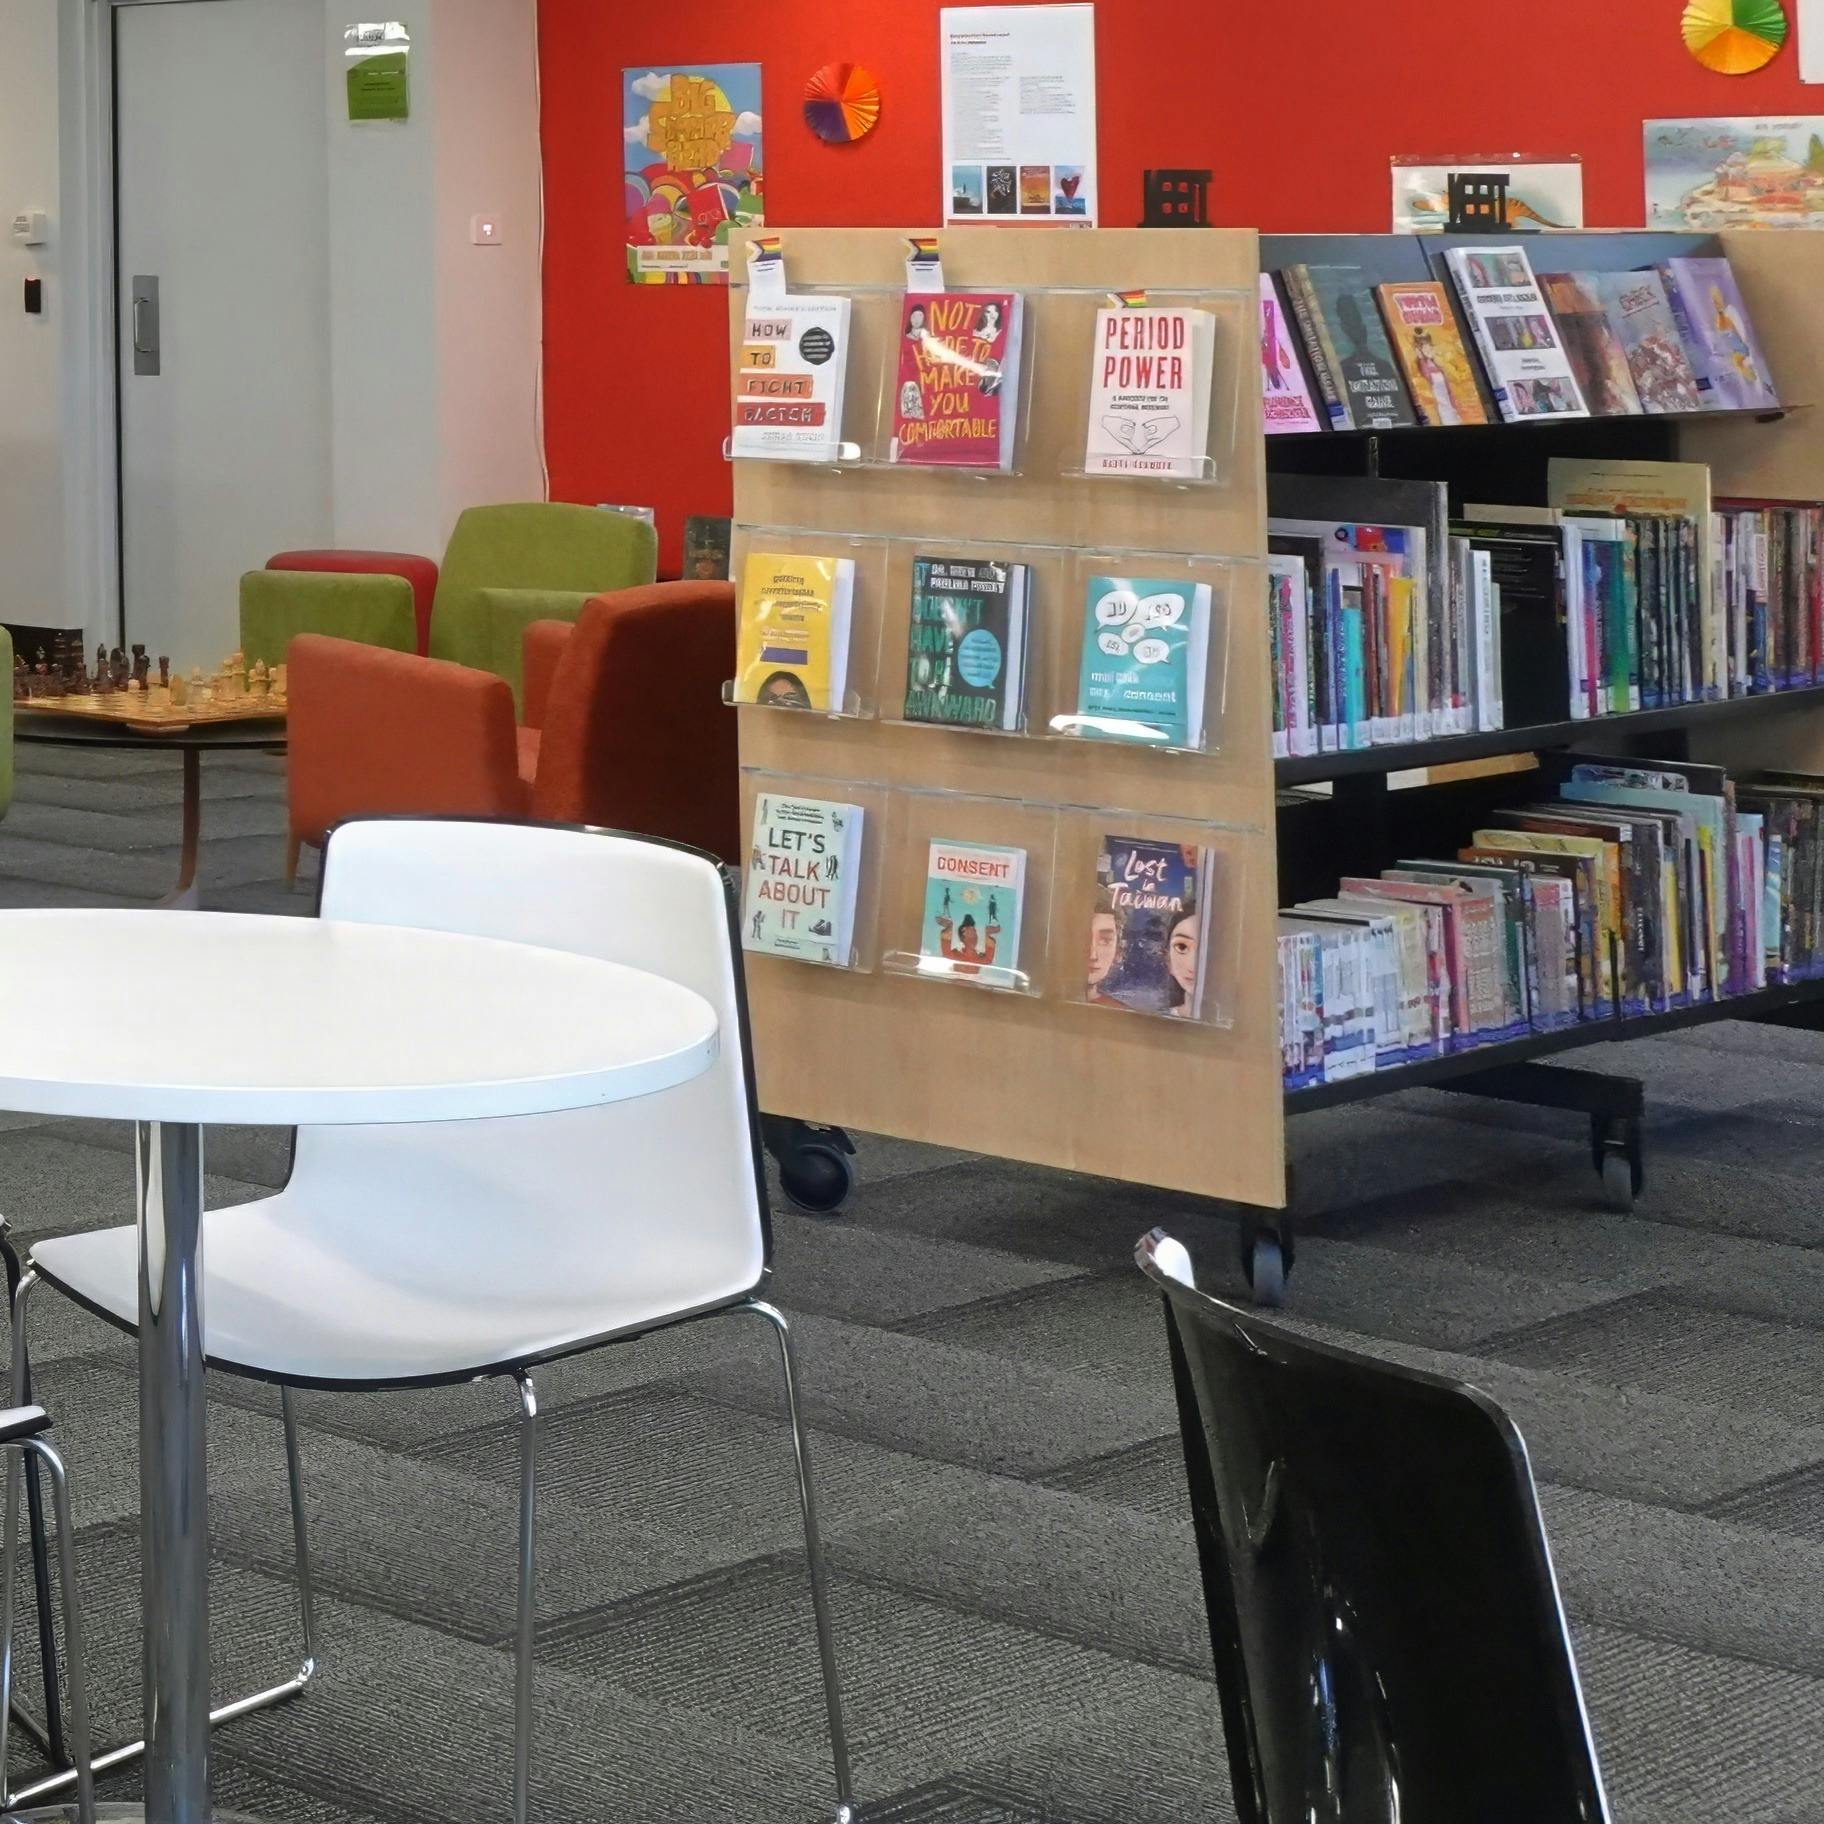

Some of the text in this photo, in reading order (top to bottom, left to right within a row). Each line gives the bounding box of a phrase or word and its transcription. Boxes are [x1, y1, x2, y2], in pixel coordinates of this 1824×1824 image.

[752, 323, 788, 337] HOW
[930, 300, 981, 335] NOT
[1105, 317, 1185, 350] PERIOD
[750, 352, 771, 365] TO
[912, 337, 967, 371] HRE
[920, 366, 976, 394] MAKE
[1103, 356, 1183, 389] POWER
[929, 392, 969, 417] YOU
[898, 419, 997, 446] COMFORTABLE
[768, 827, 827, 854] LET'S
[769, 854, 821, 880] TALK
[937, 856, 1010, 880] CONSENT
[1123, 849, 1169, 882] Lost
[758, 879, 830, 909] ABOUT
[1108, 881, 1184, 913] Taiwan
[781, 910, 800, 930] IT
